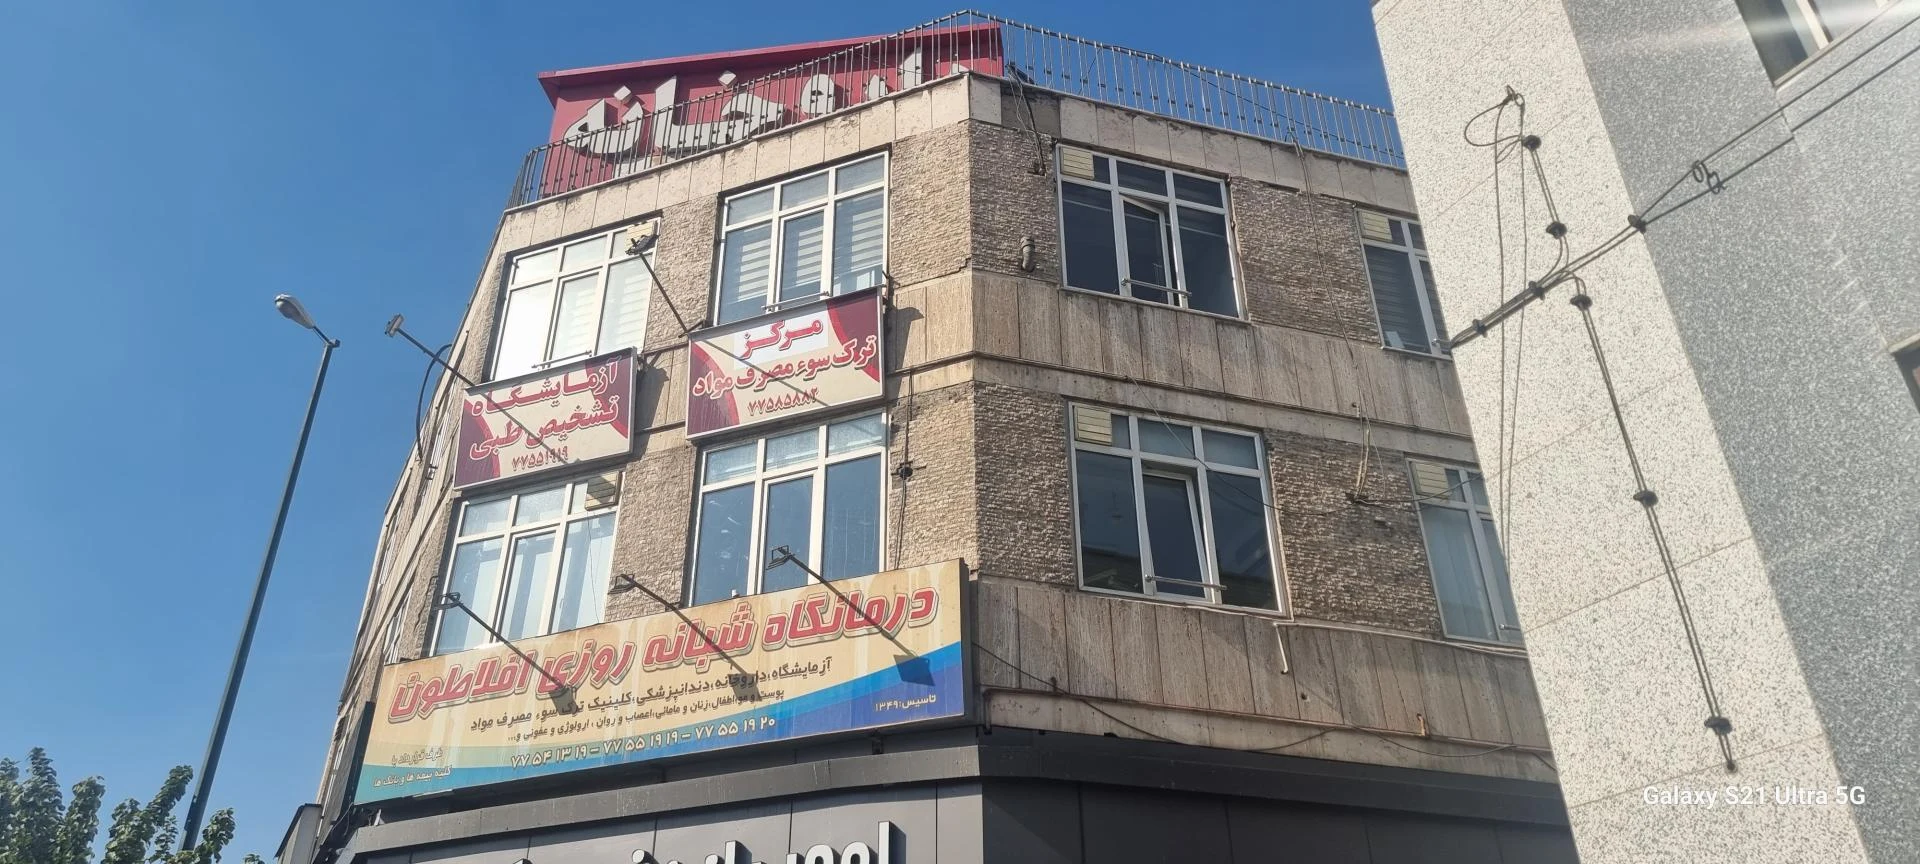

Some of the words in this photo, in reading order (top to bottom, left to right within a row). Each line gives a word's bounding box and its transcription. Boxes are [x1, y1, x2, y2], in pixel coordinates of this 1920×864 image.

[563, 48, 971, 155] اوخانه
[741, 317, 823, 360] مرکز
[832, 335, 876, 369] ترک
[471, 355, 622, 415] آزمایشگاه
[692, 371, 735, 400] مواد
[735, 360, 795, 392] مصرف
[797, 354, 831, 381] سوء
[470, 421, 523, 461] طبی
[525, 394, 620, 449] تشخیص
[642, 600, 758, 673] شبانه
[762, 586, 939, 648] درمانگاه
[388, 650, 536, 724] افلاطون
[535, 638, 637, 701] روزی
[470, 718, 493, 732] مواد
[497, 711, 532, 728] مصرف
